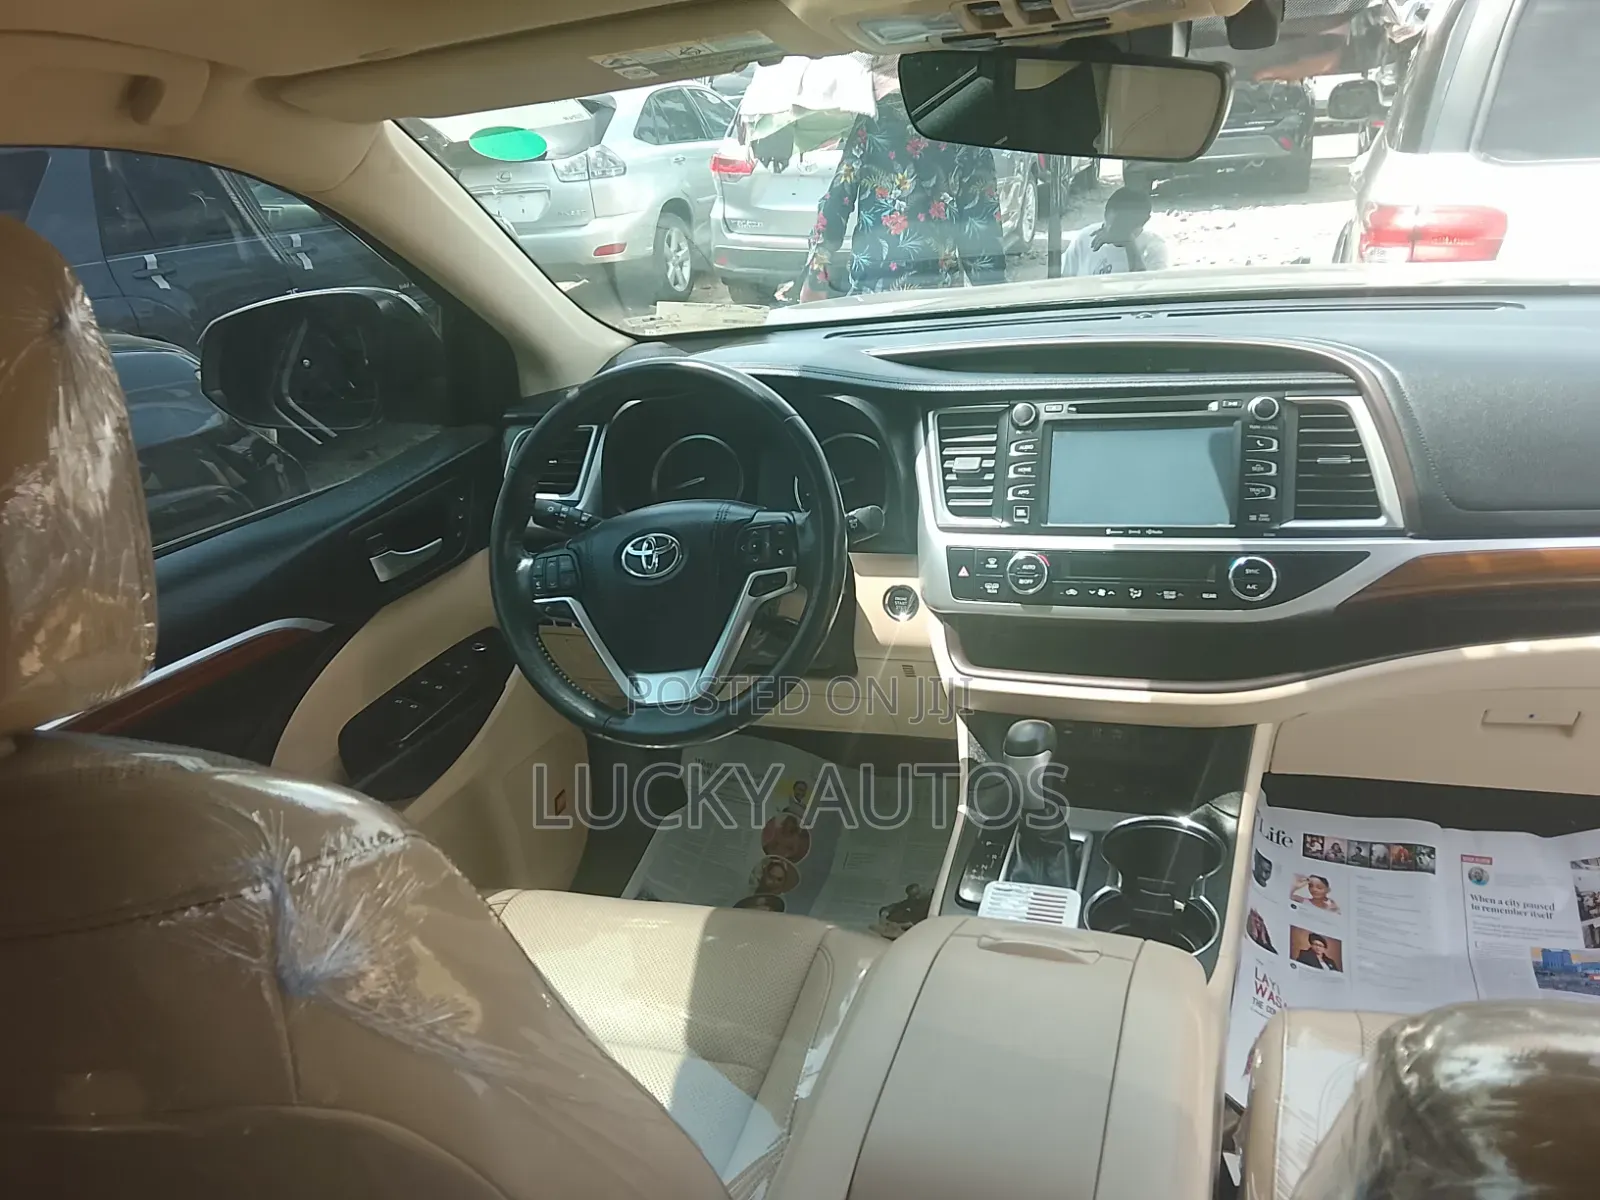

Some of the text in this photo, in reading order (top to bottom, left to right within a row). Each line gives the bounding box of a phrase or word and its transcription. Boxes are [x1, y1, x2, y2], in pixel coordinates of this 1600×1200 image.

[1259, 818, 1293, 848] Life
[1470, 893, 1495, 905] When
[1504, 898, 1520, 908] city
[1523, 901, 1555, 912] paused
[1471, 902, 1554, 919] to remember itself
[1252, 996, 1264, 1009] THE
